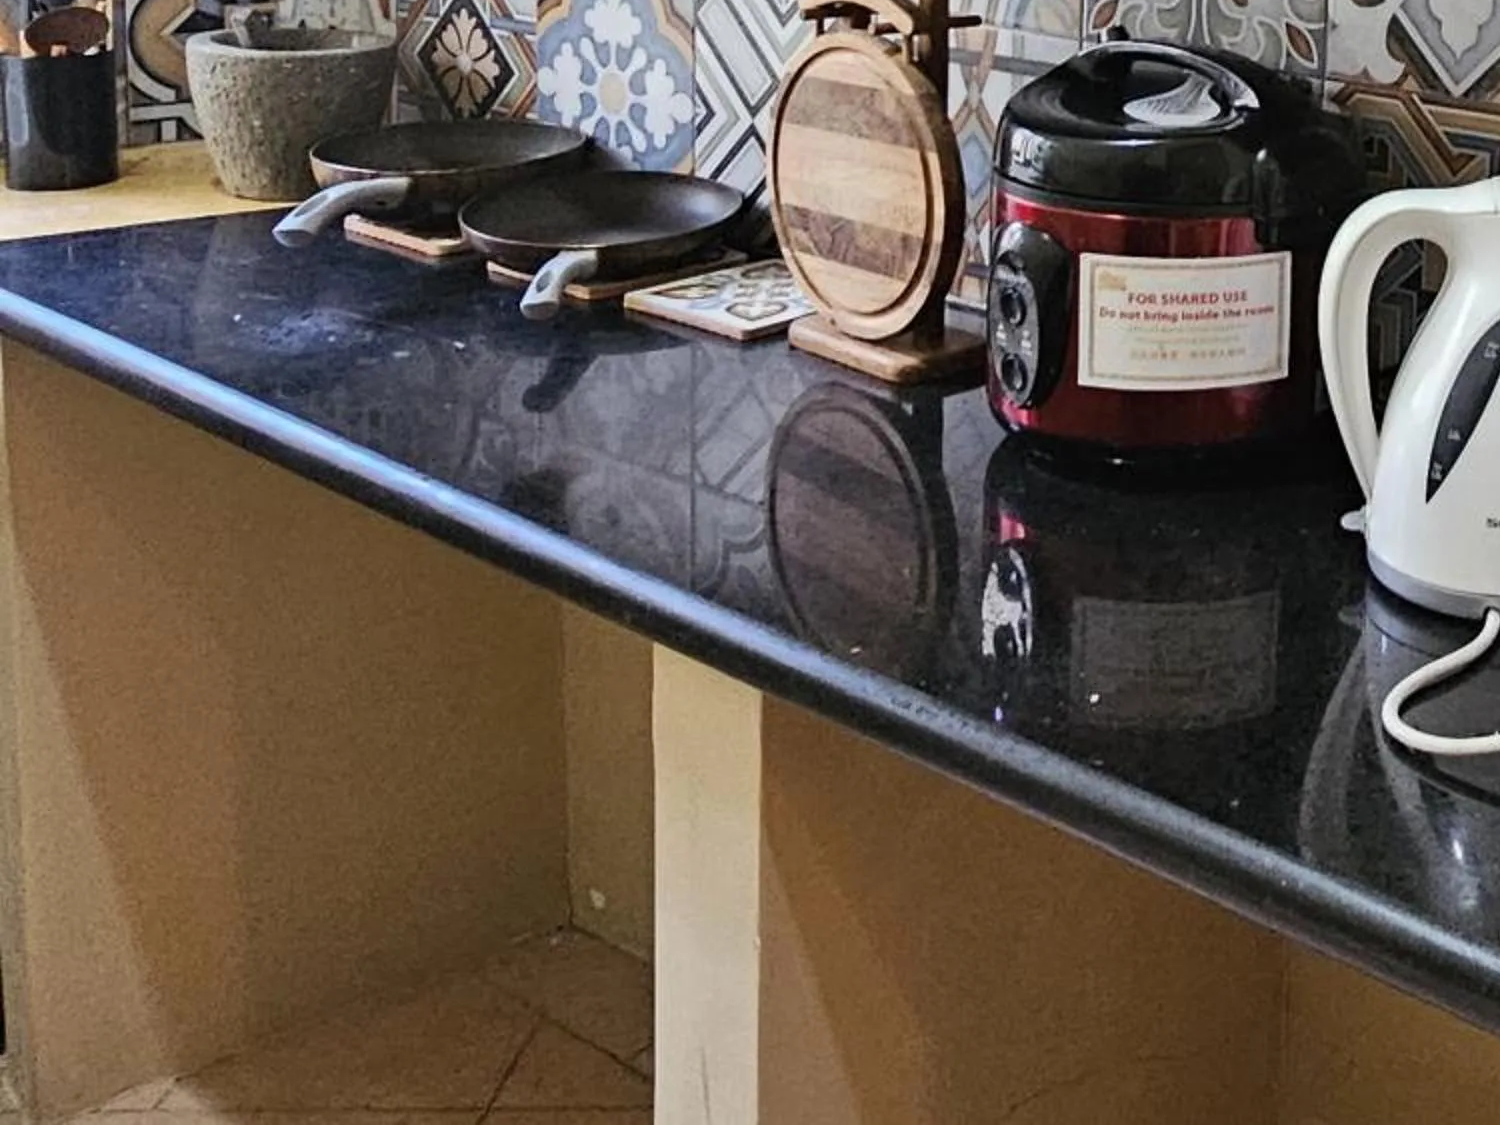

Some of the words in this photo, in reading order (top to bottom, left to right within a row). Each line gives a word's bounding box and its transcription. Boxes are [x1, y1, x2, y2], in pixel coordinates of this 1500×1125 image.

[1128, 292, 1157, 304] FOR
[1161, 291, 1220, 305] SHARED
[1223, 290, 1248, 303] USE
[1099, 306, 1116, 318] Do
[1119, 308, 1141, 320] not
[1143, 308, 1178, 323] bring
[1181, 307, 1219, 320] inside
[1223, 305, 1242, 317] the
[1245, 304, 1275, 315] room
